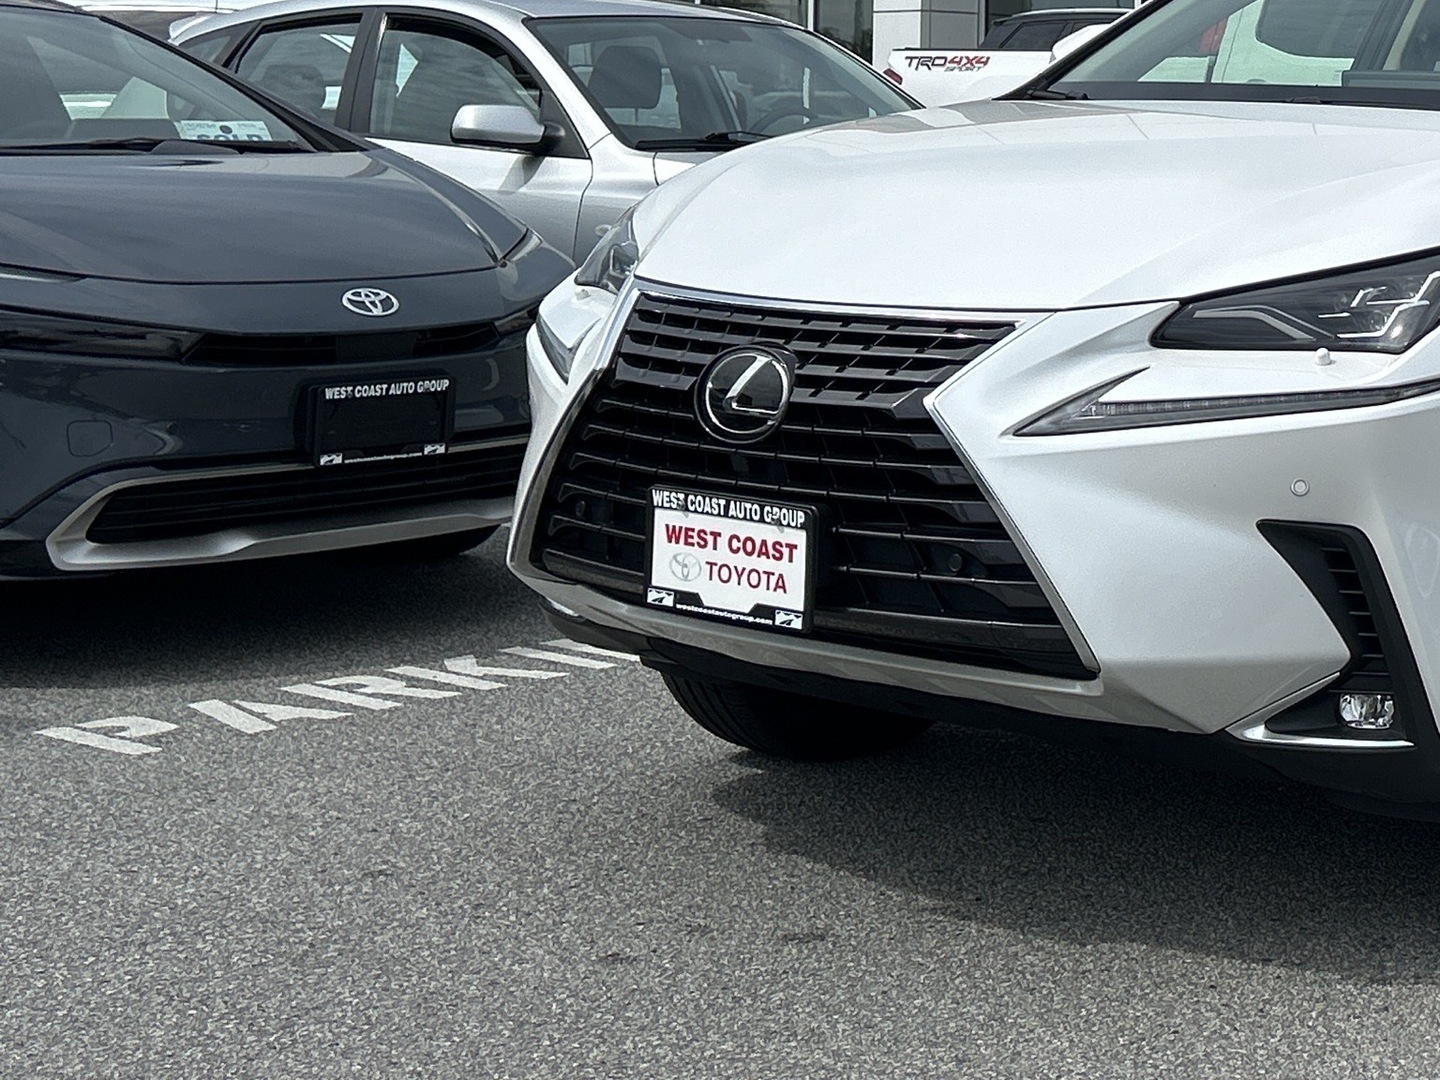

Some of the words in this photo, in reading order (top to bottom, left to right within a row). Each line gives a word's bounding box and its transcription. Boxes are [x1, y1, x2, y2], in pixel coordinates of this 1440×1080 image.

[325, 386, 353, 399] WEST
[354, 384, 388, 397] COAST
[389, 382, 415, 395] AUTO
[416, 379, 450, 393] GROUP
[651, 489, 685, 509] WEST
[687, 494, 726, 516] COAST
[728, 500, 761, 520] AUTO
[763, 506, 806, 528] GROUP
[664, 523, 722, 551] WEST
[727, 533, 798, 563] COAST
[705, 561, 788, 594] TOYOTA
